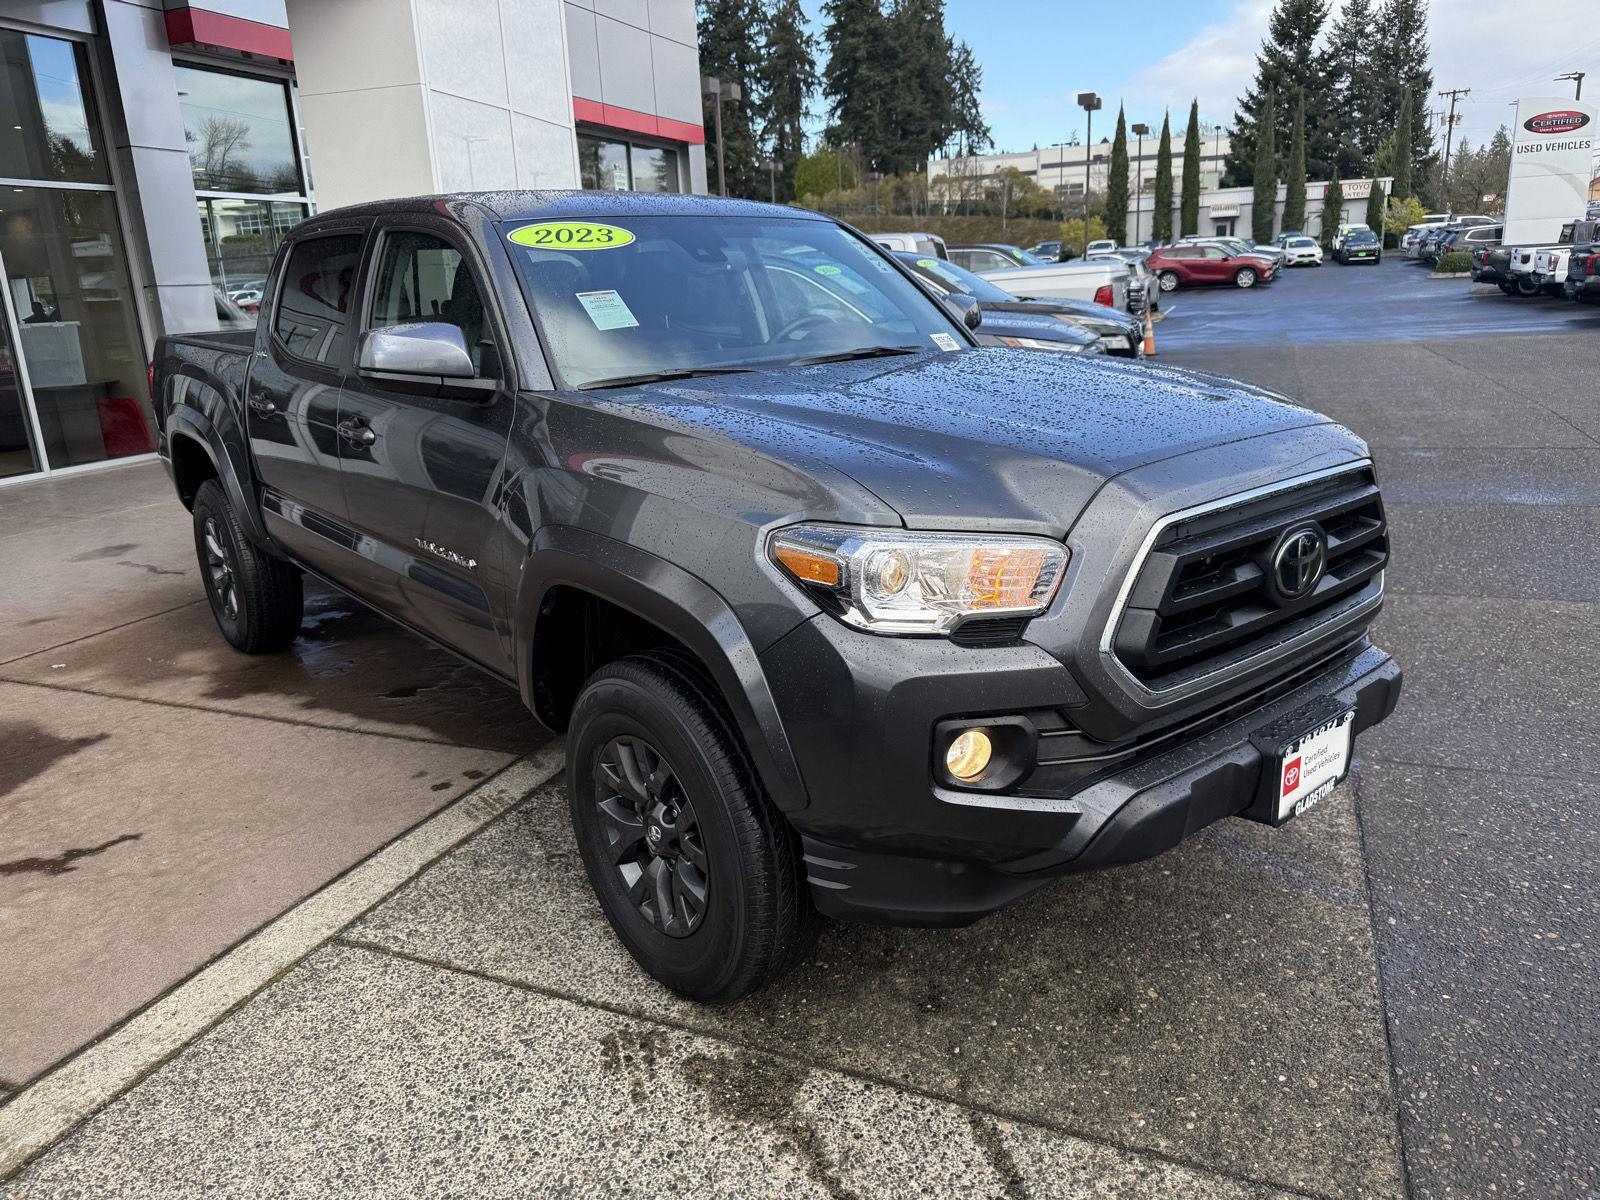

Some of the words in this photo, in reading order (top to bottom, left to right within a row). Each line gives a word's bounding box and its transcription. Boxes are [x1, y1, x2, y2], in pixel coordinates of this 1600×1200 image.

[1532, 117, 1582, 128] CERTIFIED
[1517, 144, 1543, 154] USED
[1545, 140, 1591, 151] VEHICLES
[1348, 183, 1370, 191] TOYO
[534, 227, 614, 244] 2023
[1304, 743, 1328, 765] Certified
[1303, 762, 1318, 778] Used
[1317, 751, 1340, 769] Vehicles
[1295, 777, 1335, 816] GLADSTONE
